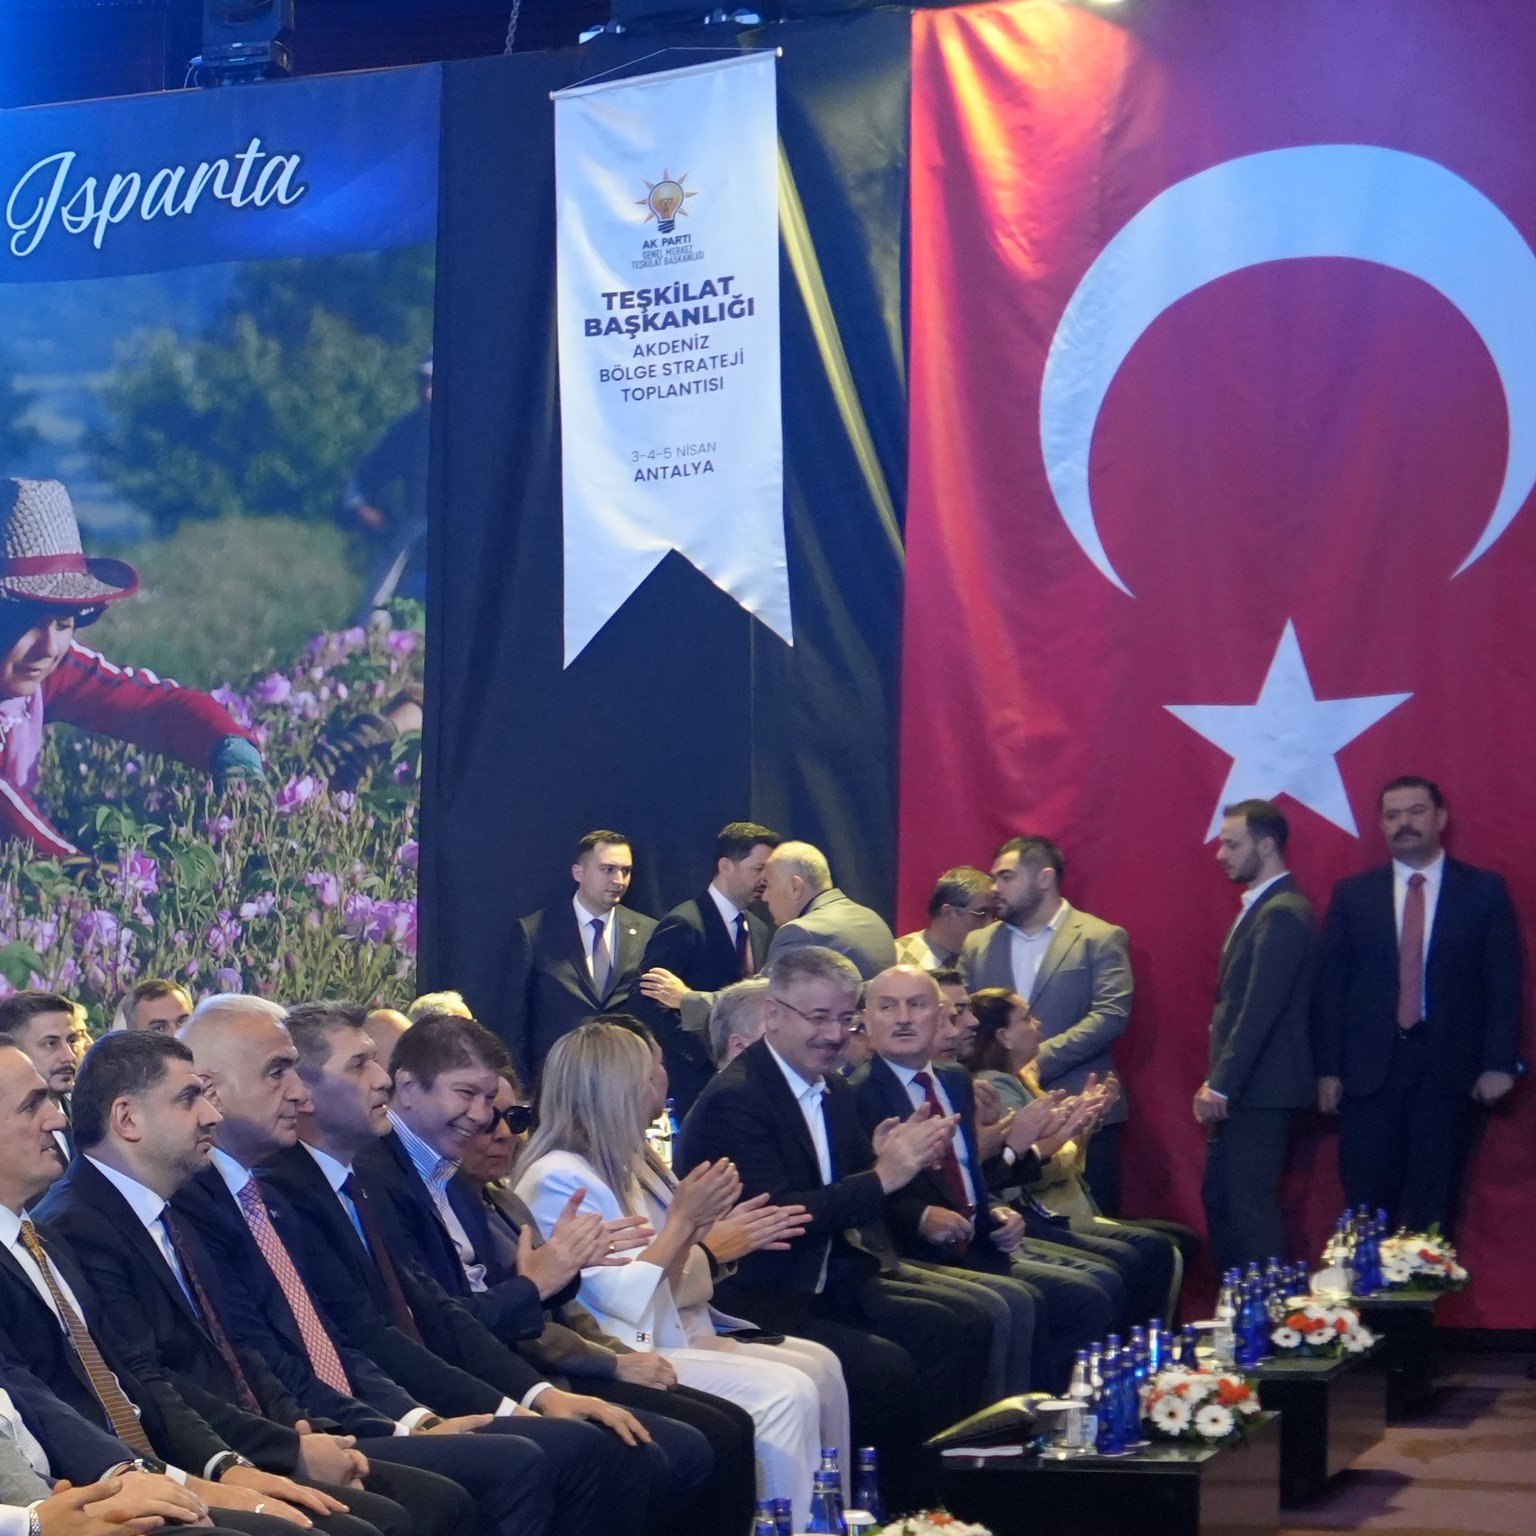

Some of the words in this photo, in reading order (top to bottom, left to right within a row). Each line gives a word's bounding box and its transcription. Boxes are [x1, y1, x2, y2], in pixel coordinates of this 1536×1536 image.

[6, 137, 308, 257] Isparta
[642, 239, 658, 249] AK
[601, 275, 734, 313] TEŞKİLAT
[584, 293, 755, 339] BAŞKANLIĞI
[632, 333, 710, 358] AKDENİZ
[599, 364, 657, 382] BÖLGE
[662, 347, 744, 377] STRATEJİ
[621, 376, 724, 402] TOPLANTISI
[631, 447, 672, 463] 3-4-5
[634, 460, 715, 482] ANTALYA
